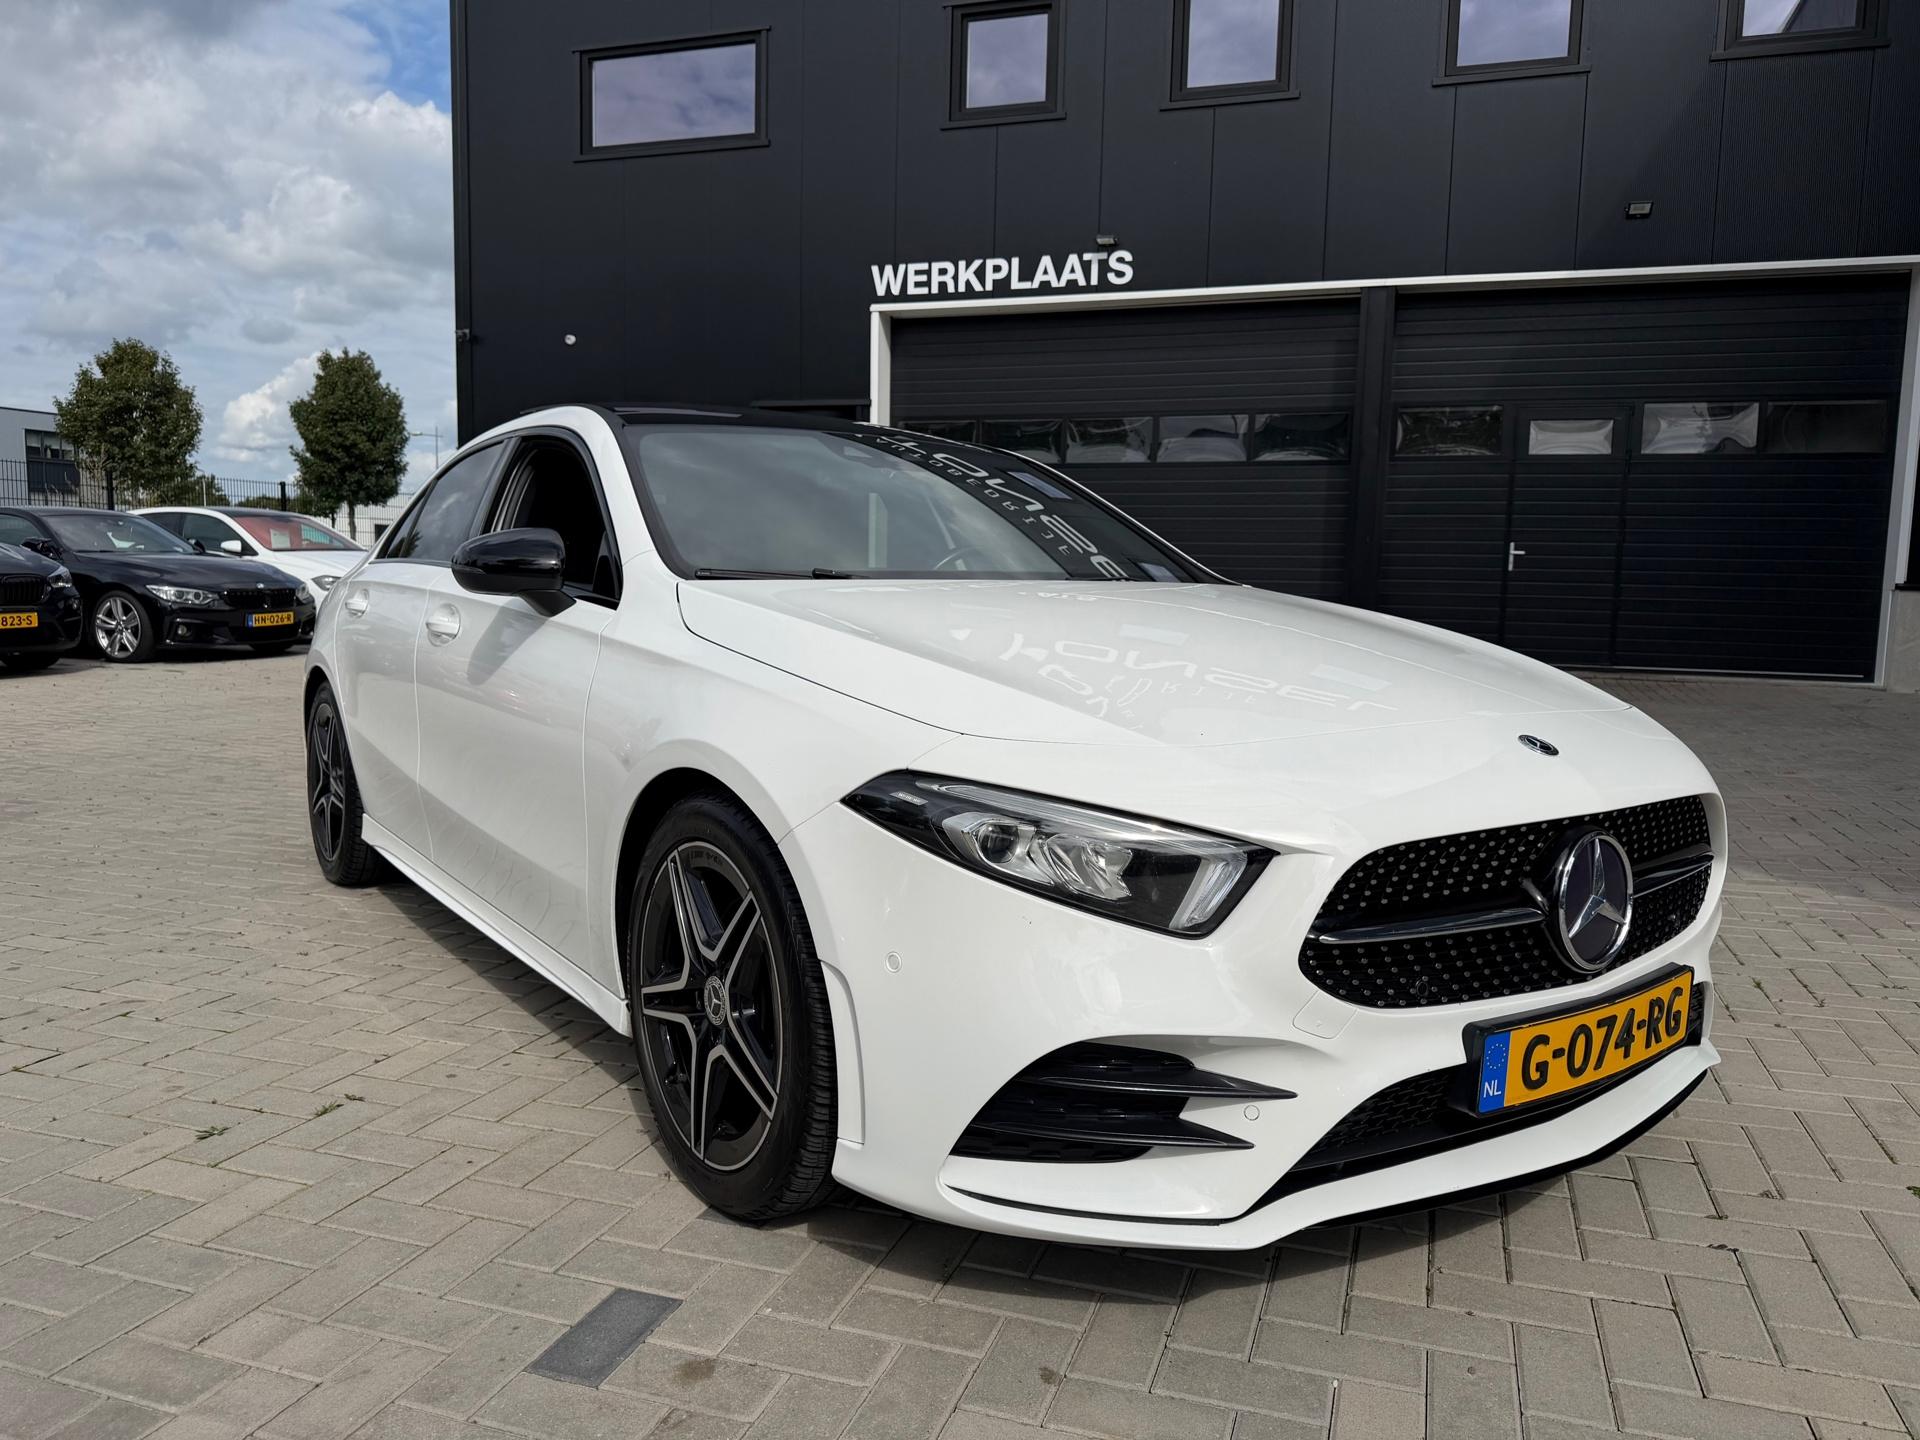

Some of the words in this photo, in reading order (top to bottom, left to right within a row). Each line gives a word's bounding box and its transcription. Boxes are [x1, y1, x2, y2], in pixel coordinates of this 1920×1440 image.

[870, 250, 1134, 297] WERKPLAATS
[1, 615, 33, 627] 823-S
[254, 613, 292, 625] HN-026-R
[1521, 986, 1684, 1091] G-074-RG
[1483, 1079, 1502, 1098] NL
